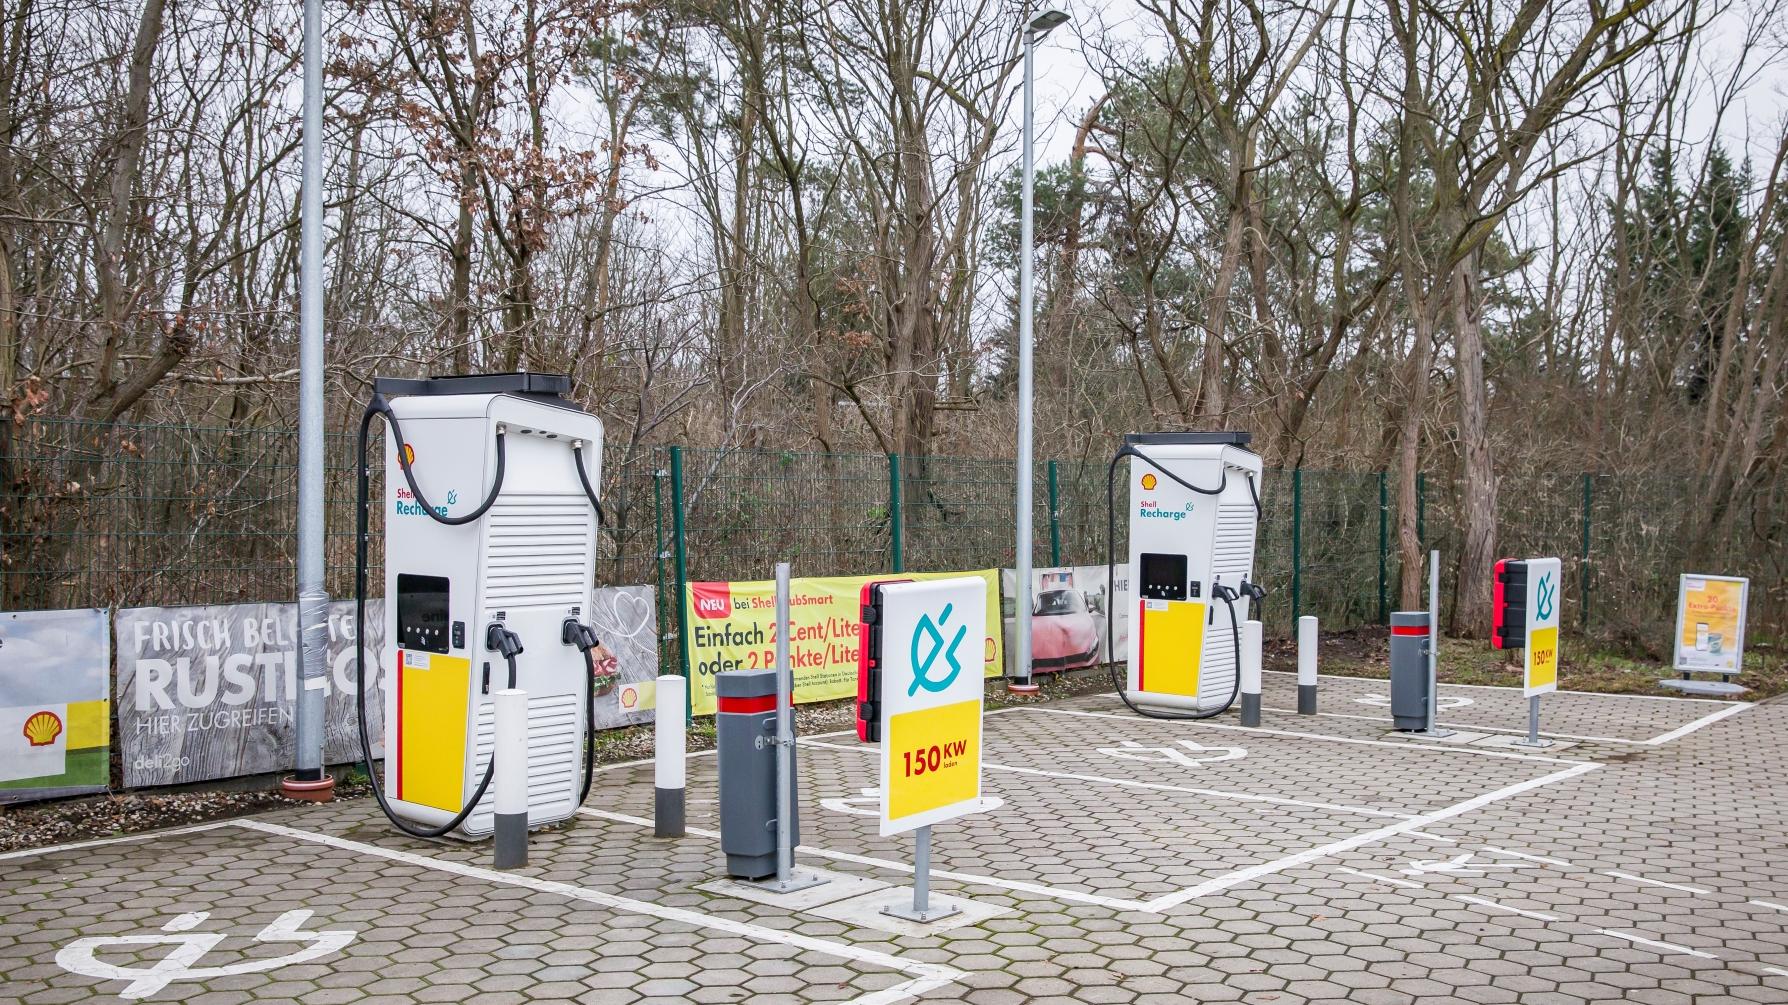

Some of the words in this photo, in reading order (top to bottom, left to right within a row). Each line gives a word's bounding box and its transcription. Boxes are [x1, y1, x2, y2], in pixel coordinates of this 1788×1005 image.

[396, 500, 448, 517] Rechge
[1140, 508, 1186, 520] Recharge
[1113, 579, 1129, 592] HIE
[700, 599, 725, 611] NEU
[733, 597, 750, 610] bei
[790, 594, 834, 606] ubSmart
[133, 620, 232, 653] FRISCH
[694, 621, 764, 648] Einfach
[788, 616, 860, 643] Cent/Lite
[698, 651, 744, 676] oder
[748, 651, 758, 669] 2
[764, 642, 859, 670] Pnkte/Lite
[1533, 650, 1545, 666] 150
[136, 713, 182, 735] HIER
[187, 706, 294, 732] ZUGREIFEN
[133, 753, 190, 772] deli2go
[903, 745, 941, 778] 150
[943, 739, 967, 760] KW
[943, 760, 958, 769] laden
